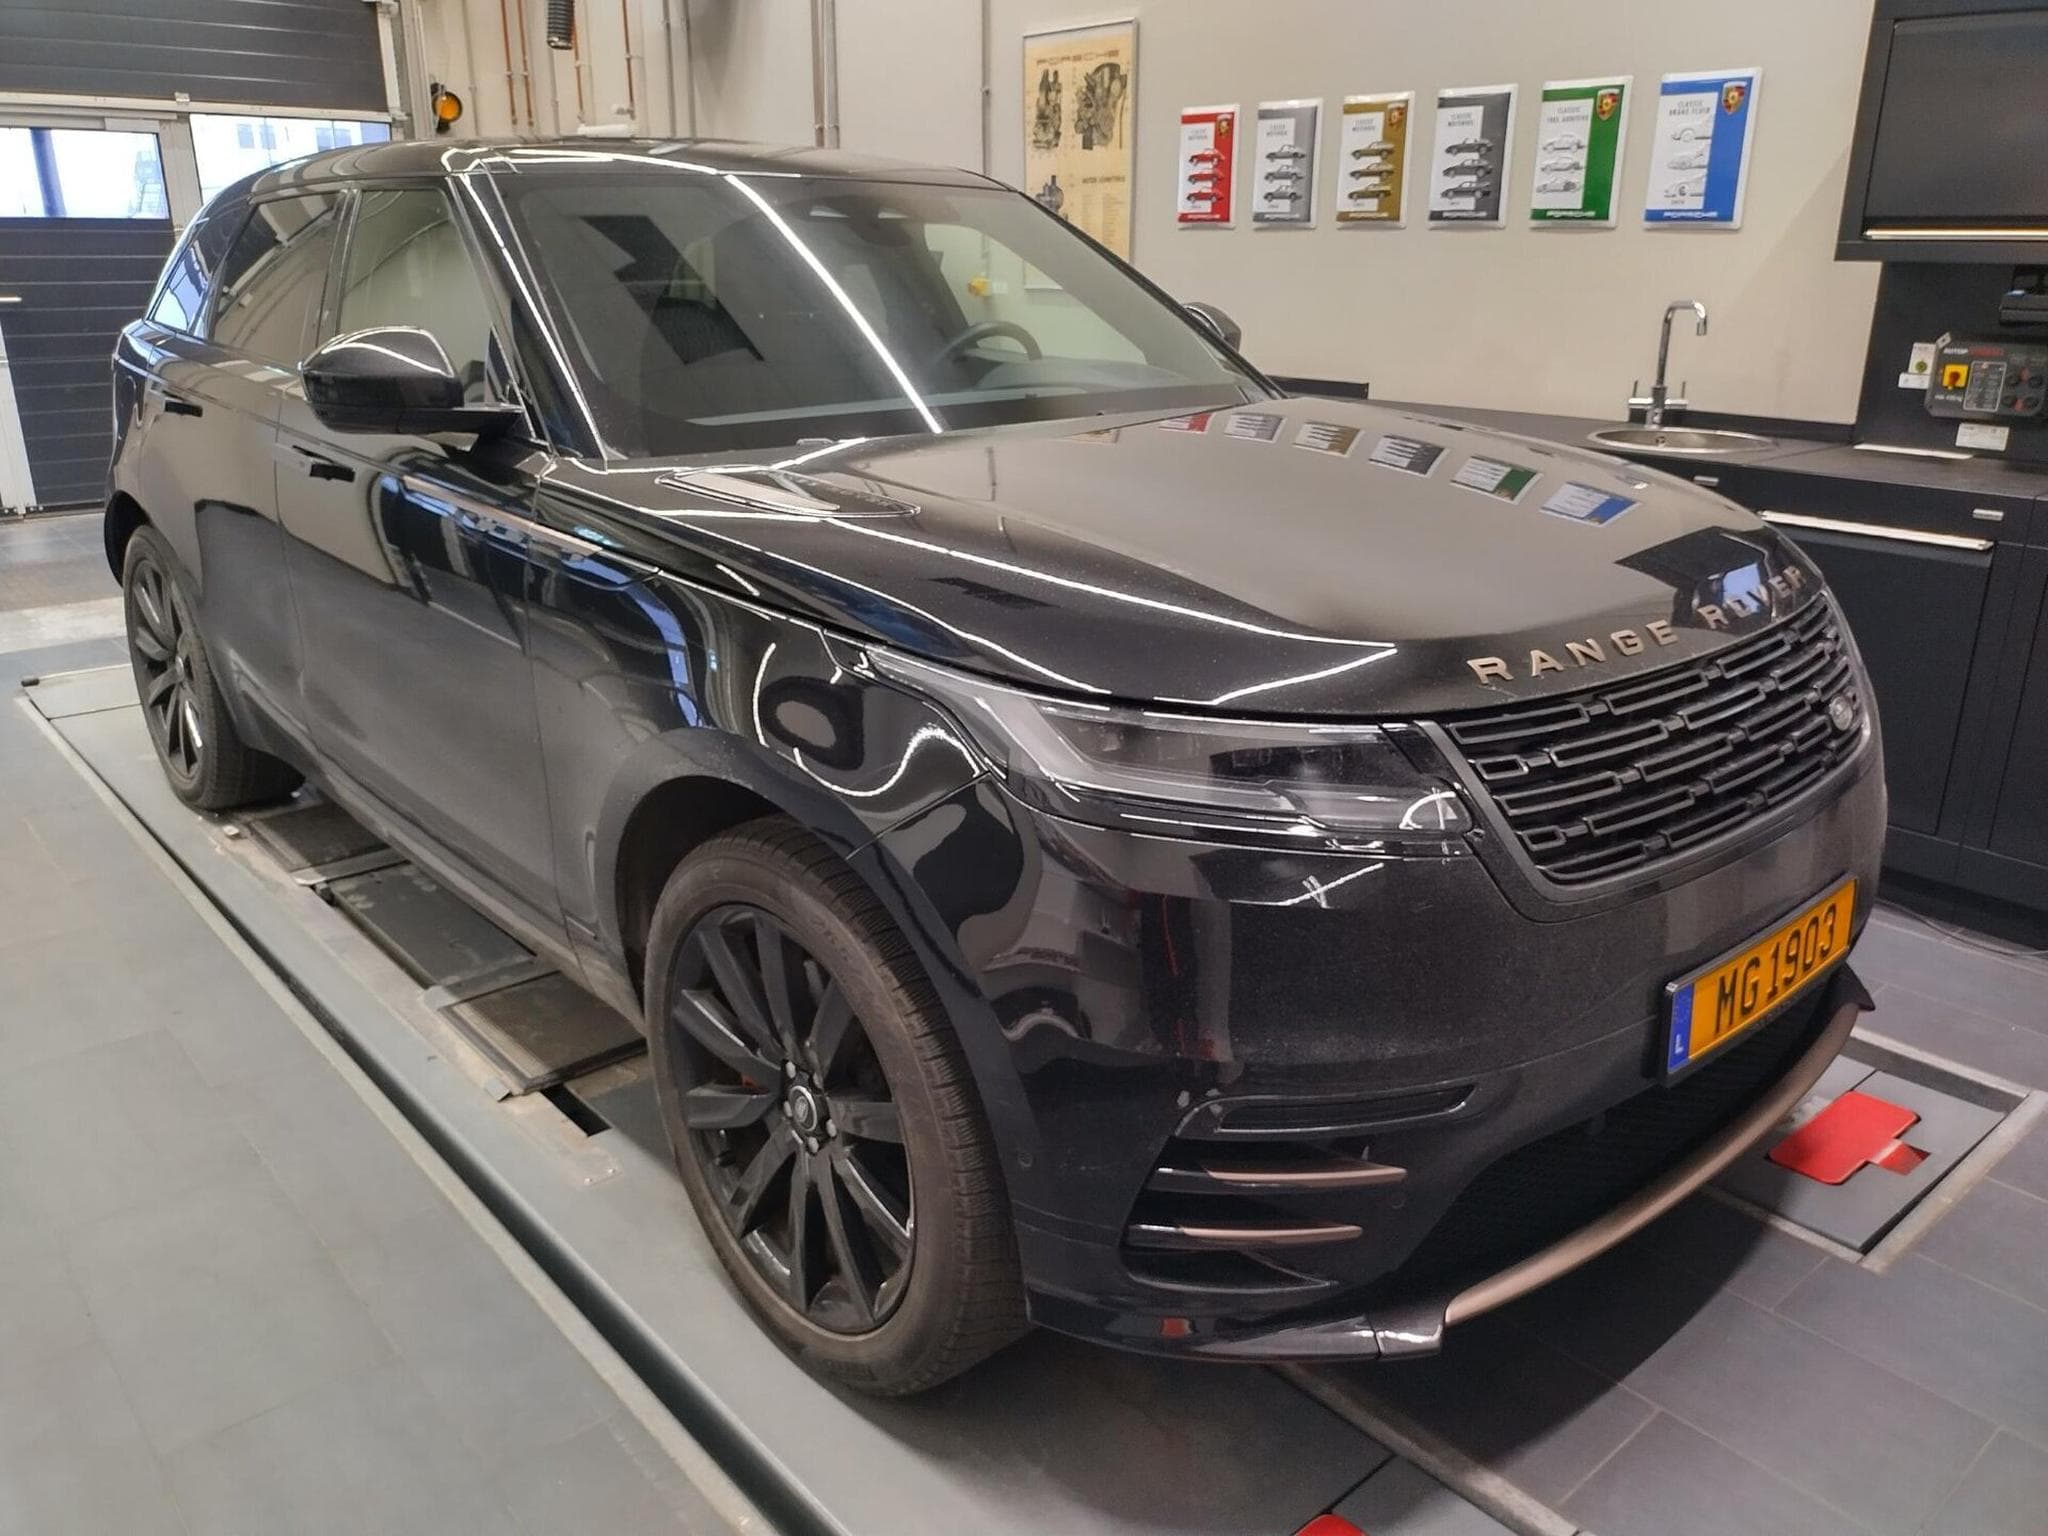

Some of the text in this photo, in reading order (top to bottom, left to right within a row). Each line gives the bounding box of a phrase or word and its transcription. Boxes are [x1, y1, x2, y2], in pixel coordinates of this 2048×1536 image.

[1466, 565, 1807, 685] RANGE ROVER
[1674, 1034, 1682, 1054] L
